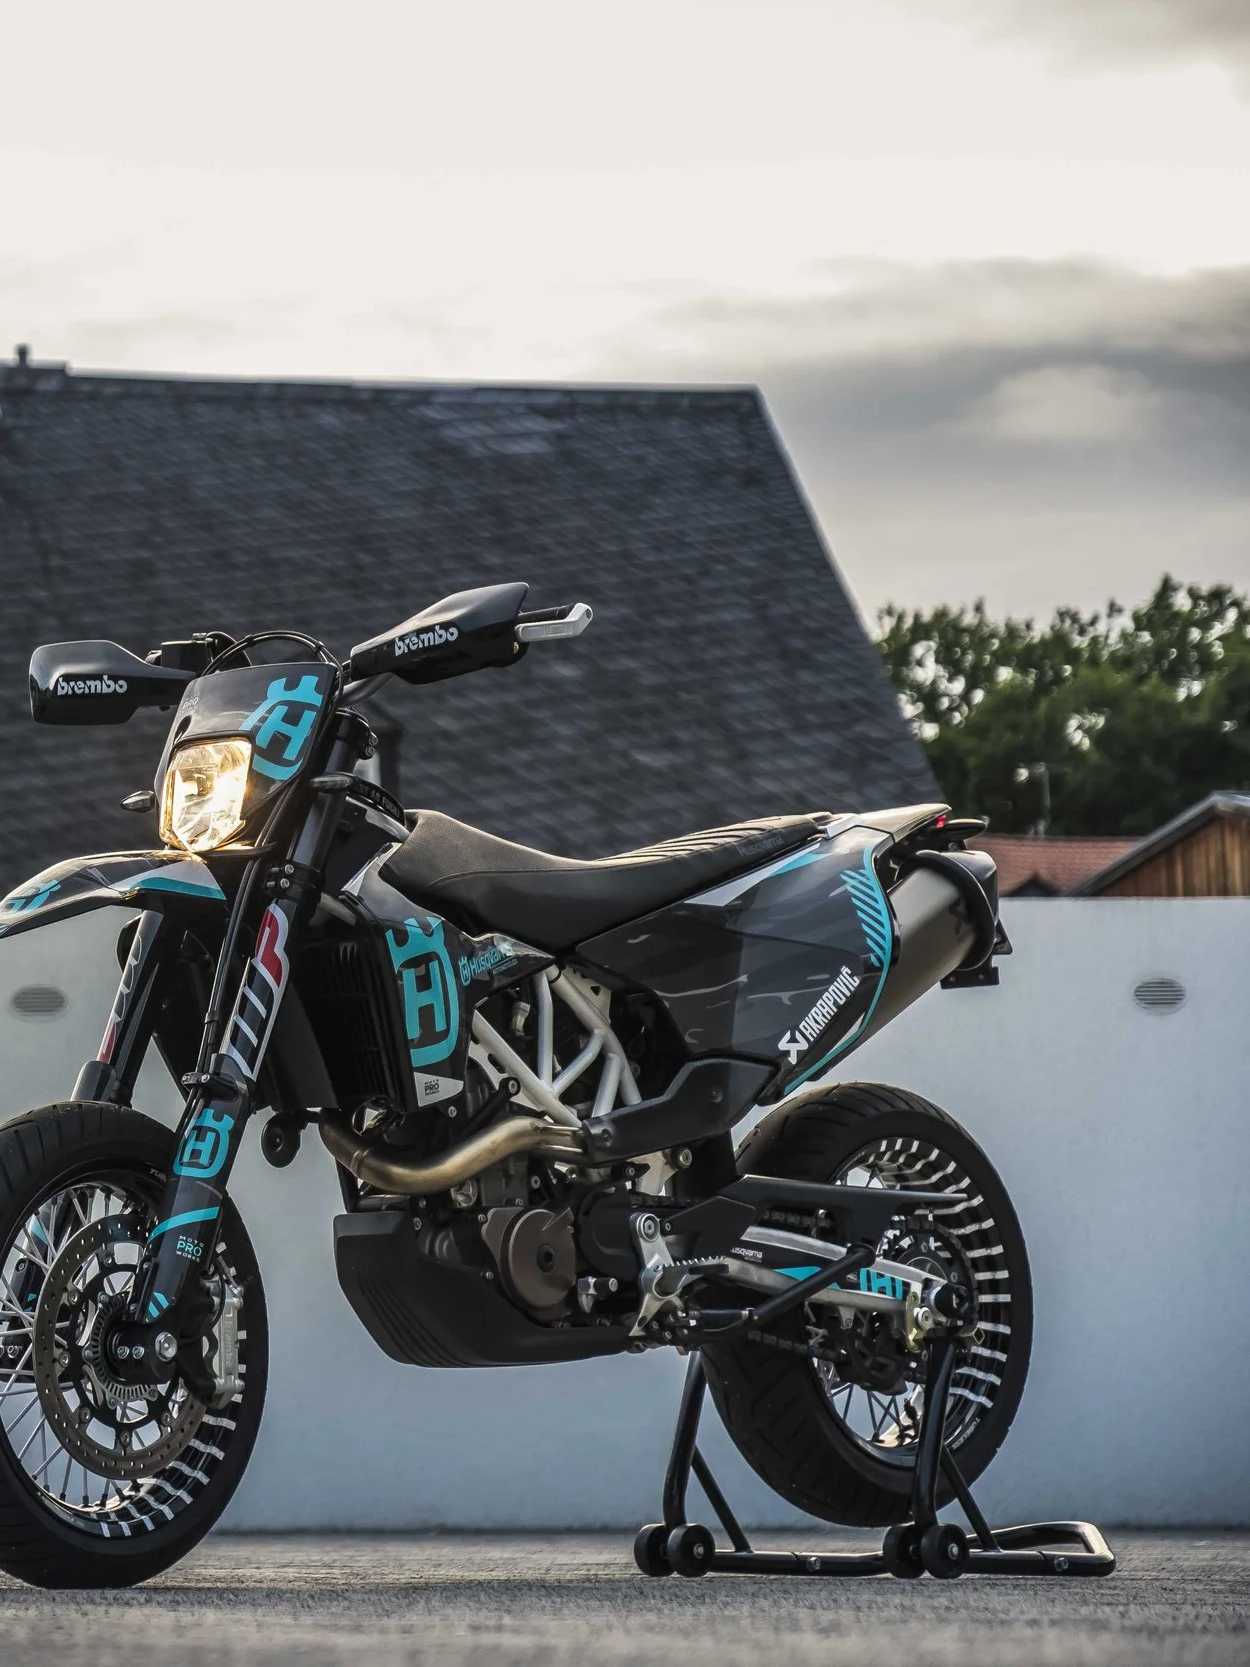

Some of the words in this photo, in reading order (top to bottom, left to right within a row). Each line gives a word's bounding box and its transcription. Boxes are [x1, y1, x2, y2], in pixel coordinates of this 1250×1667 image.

[395, 625, 459, 657] brembo
[57, 675, 128, 696] brembo
[424, 1083, 440, 1092] PRO
[177, 1240, 202, 1257] PRO
[179, 1235, 204, 1248] MOTO
[176, 1250, 200, 1263] WORKS
